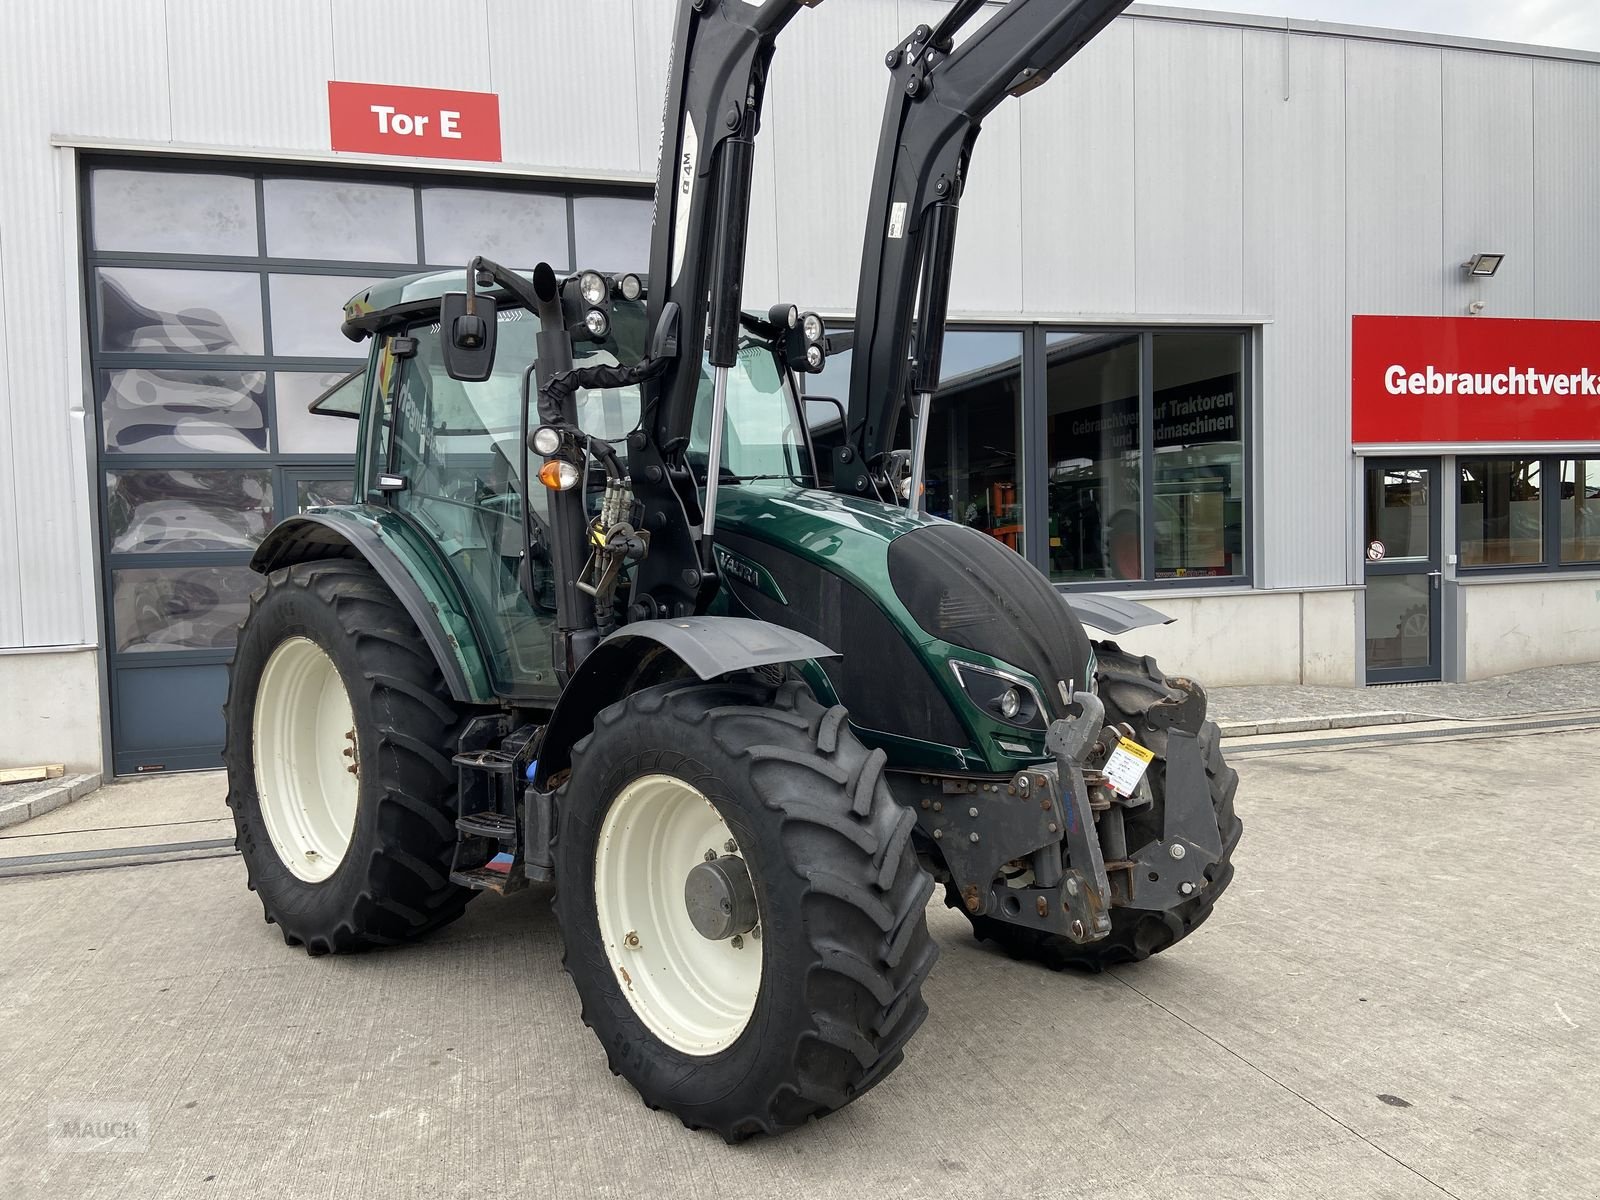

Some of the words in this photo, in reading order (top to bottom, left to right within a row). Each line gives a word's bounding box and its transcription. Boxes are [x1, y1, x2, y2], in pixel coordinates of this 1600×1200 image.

[370, 104, 429, 136] Tor
[439, 110, 462, 139] E
[1384, 364, 1600, 395] Gebrauchtverk
[1072, 402, 1168, 435] Gebrauchtveruf
[1169, 391, 1234, 416] Traktoren
[1113, 429, 1133, 447] und
